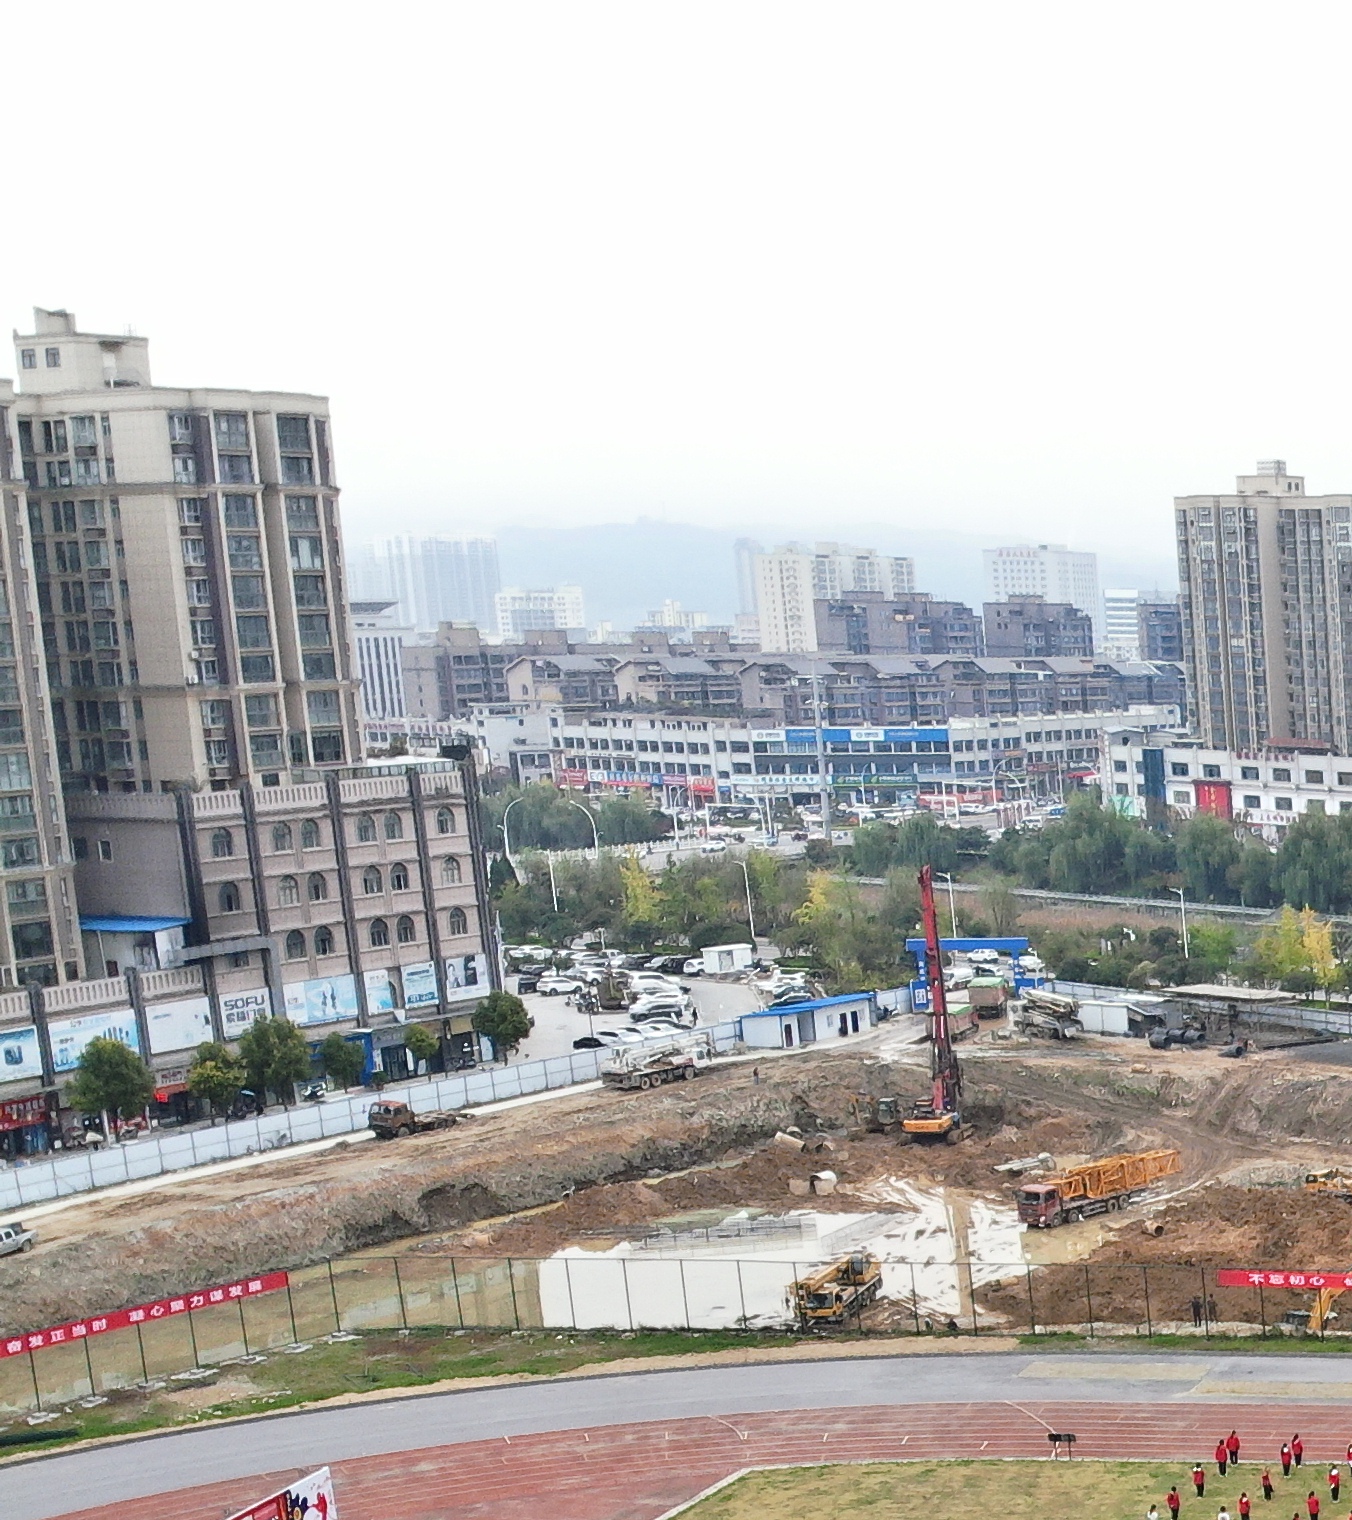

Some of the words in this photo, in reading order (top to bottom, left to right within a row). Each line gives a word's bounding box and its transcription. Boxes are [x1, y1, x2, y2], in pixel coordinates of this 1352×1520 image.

[224, 994, 265, 1011] SOFU
[1249, 1273, 1325, 1286] 不忘初心
